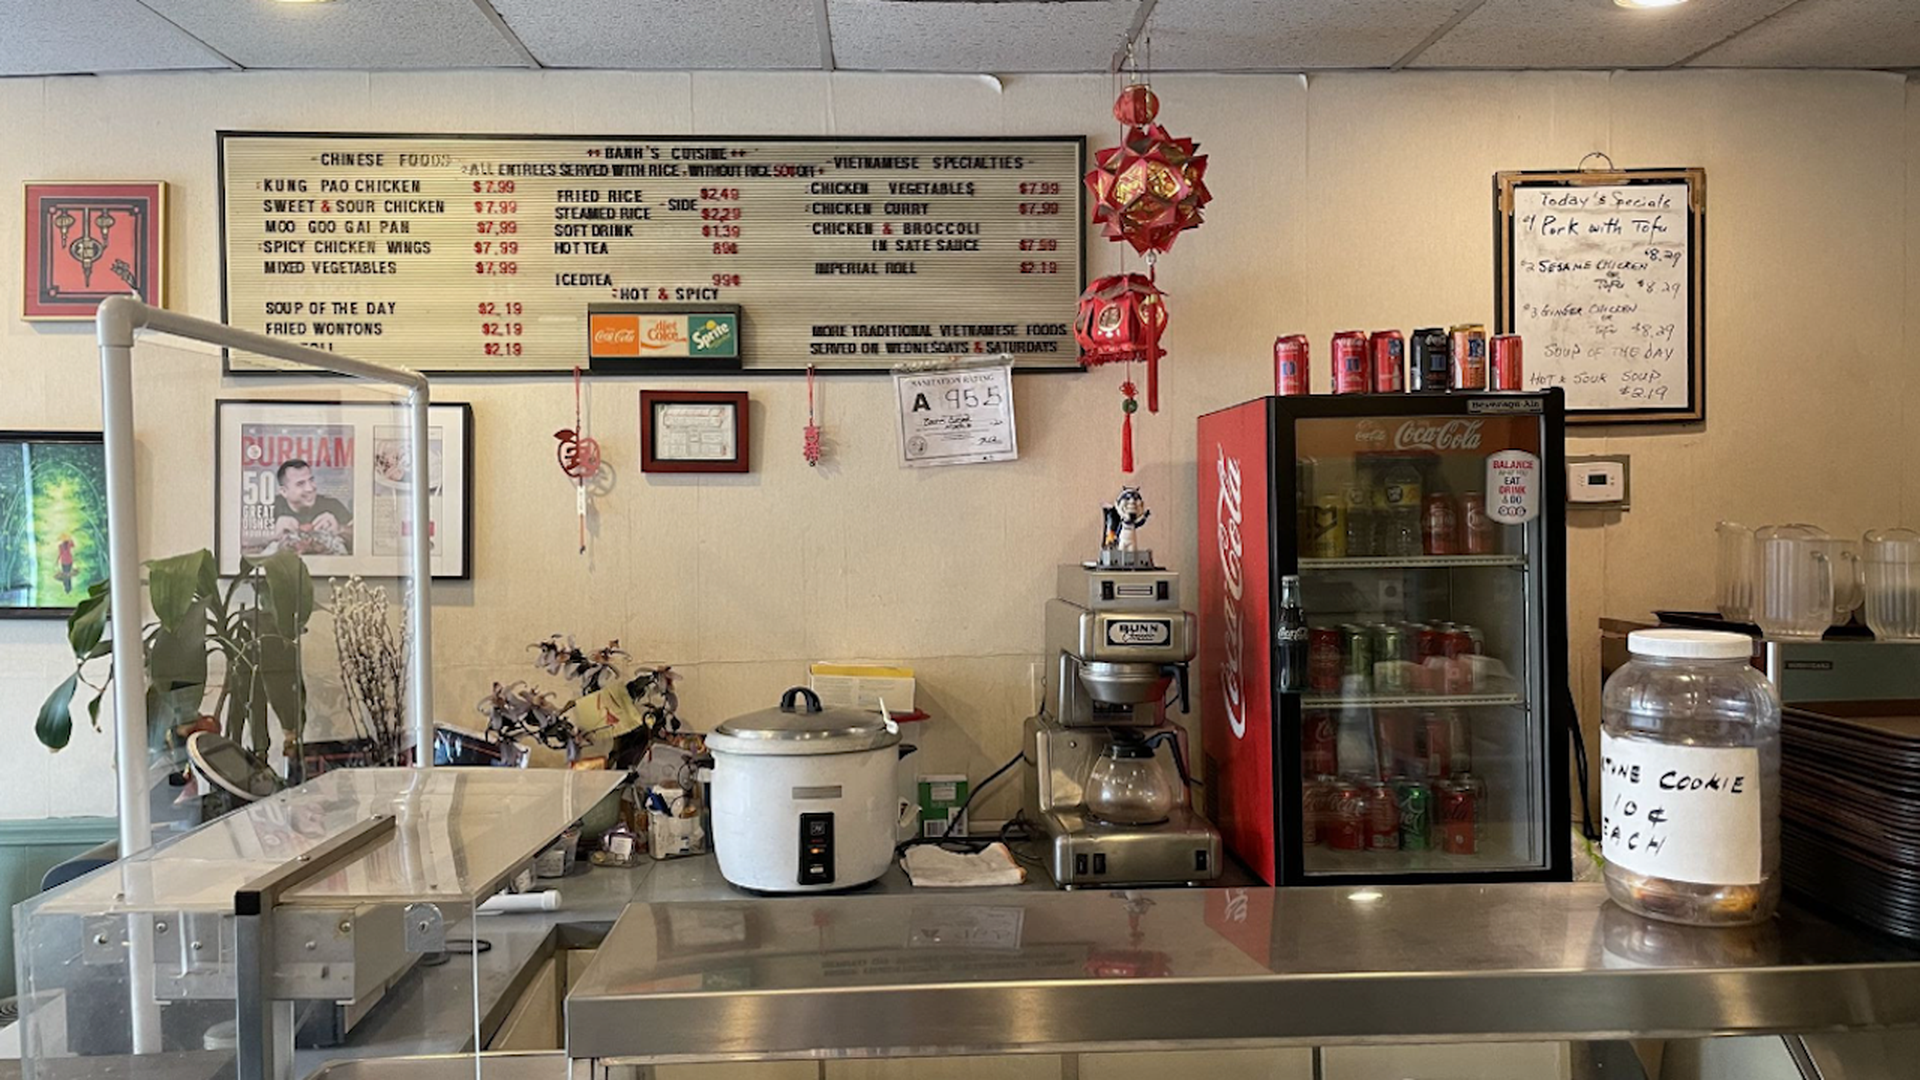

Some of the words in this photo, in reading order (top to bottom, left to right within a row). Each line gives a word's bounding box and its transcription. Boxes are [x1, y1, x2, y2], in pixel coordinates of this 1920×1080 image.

[605, 146, 659, 160] BANH'S
[671, 147, 727, 160] CUISINE
[498, 164, 556, 176] ENTREES
[560, 164, 608, 177] SERVED
[612, 164, 645, 177] WITH
[650, 164, 679, 177] RICE
[263, 179, 307, 193] KUNG
[321, 179, 349, 193] PAO
[355, 179, 421, 193] CHICKEN
[811, 182, 869, 194] CHICKEN
[889, 182, 974, 196] VEGETABLES
[1019, 182, 1059, 195] $7.99
[557, 190, 600, 202] FRIED
[608, 190, 642, 202] RICE
[1540, 191, 1606, 208] Today's
[1612, 190, 1671, 209] Specials
[263, 200, 315, 213] SWEET
[320, 200, 331, 213] &
[336, 200, 375, 213] SOUR
[384, 200, 444, 213] CHICKEN
[474, 200, 517, 214] $7.99
[812, 203, 872, 215] CHICKEN
[884, 203, 930, 215] CURRY
[1019, 203, 1059, 215] $7.99
[555, 207, 615, 220] STEAMED
[620, 207, 651, 220] RICE
[265, 220, 296, 234] MOO
[308, 220, 336, 234] GOO
[345, 220, 371, 234] GAI
[380, 220, 410, 234] PAN
[554, 224, 587, 237] SOFT
[592, 224, 634, 237] DRINK
[812, 222, 873, 235] CHICKEN
[882, 222, 894, 235] &
[903, 222, 979, 235] BROCCOLI
[1541, 215, 1579, 236] Pork
[1588, 218, 1622, 235] with
[1632, 215, 1667, 244] Tofu
[263, 241, 305, 254] SPICY
[314, 241, 376, 254] CHICKEN
[387, 241, 431, 254] WINGS
[554, 242, 579, 254] HOT
[583, 242, 609, 254] TEA
[872, 239, 887, 251] IN
[896, 239, 931, 251] SATE
[937, 239, 979, 251] SAUCE
[264, 261, 305, 274] MIXED
[312, 261, 397, 274] VEGETABLES
[815, 262, 878, 275] IMPERIAL
[885, 262, 917, 275] ROLL
[1020, 261, 1057, 274] $2.19
[1538, 260, 1591, 273] SESAME
[1595, 258, 1648, 271] CHICKEN
[620, 288, 649, 300] HOT
[658, 288, 669, 300] &
[676, 288, 719, 300] SPICY
[265, 301, 304, 315] SOUP
[309, 301, 326, 315] OF
[332, 301, 358, 315] THE
[366, 301, 396, 315] DAY
[478, 302, 523, 315] $2.19
[1540, 303, 1583, 318] GINGER
[1588, 302, 1638, 316] CHICKEN
[265, 322, 306, 335] FRIED
[313, 322, 382, 335] WONTONS
[482, 323, 523, 336] $2.19
[812, 325, 847, 337] MORE
[851, 325, 932, 337] TRADITIONAL
[940, 324, 1018, 336] VIETNAMESE
[1026, 323, 1068, 336] FOODS
[1631, 323, 1675, 341] $8.29
[692, 322, 730, 351] Sprite
[484, 343, 523, 356] $2.19
[810, 342, 855, 355] SERVED
[861, 342, 879, 354] ON
[885, 341, 969, 354] WEDNESDAYS
[974, 341, 983, 354] &
[986, 340, 1057, 353] SATURDAYS
[1544, 342, 1581, 360] SOUP
[1587, 346, 1604, 358] OF
[1612, 345, 1640, 358] THE
[1643, 342, 1674, 361] DAY
[1529, 372, 1554, 386] HOT
[1573, 372, 1608, 384] SOUR
[1620, 369, 1662, 384] SOUP
[1618, 386, 1669, 401] $2.19
[912, 392, 931, 413] A
[1394, 420, 1484, 450] Coca-Cola
[242, 435, 354, 468] DURHAM
[1493, 460, 1533, 469] BALANCE
[1504, 476, 1520, 485] EAT
[242, 470, 275, 506] 50
[1498, 485, 1526, 494] DRINK
[243, 505, 275, 518] GREAT
[1217, 443, 1245, 739] Coca-Cola
[1119, 624, 1159, 633] BUNN
[1659, 770, 1745, 794] COOKIE
